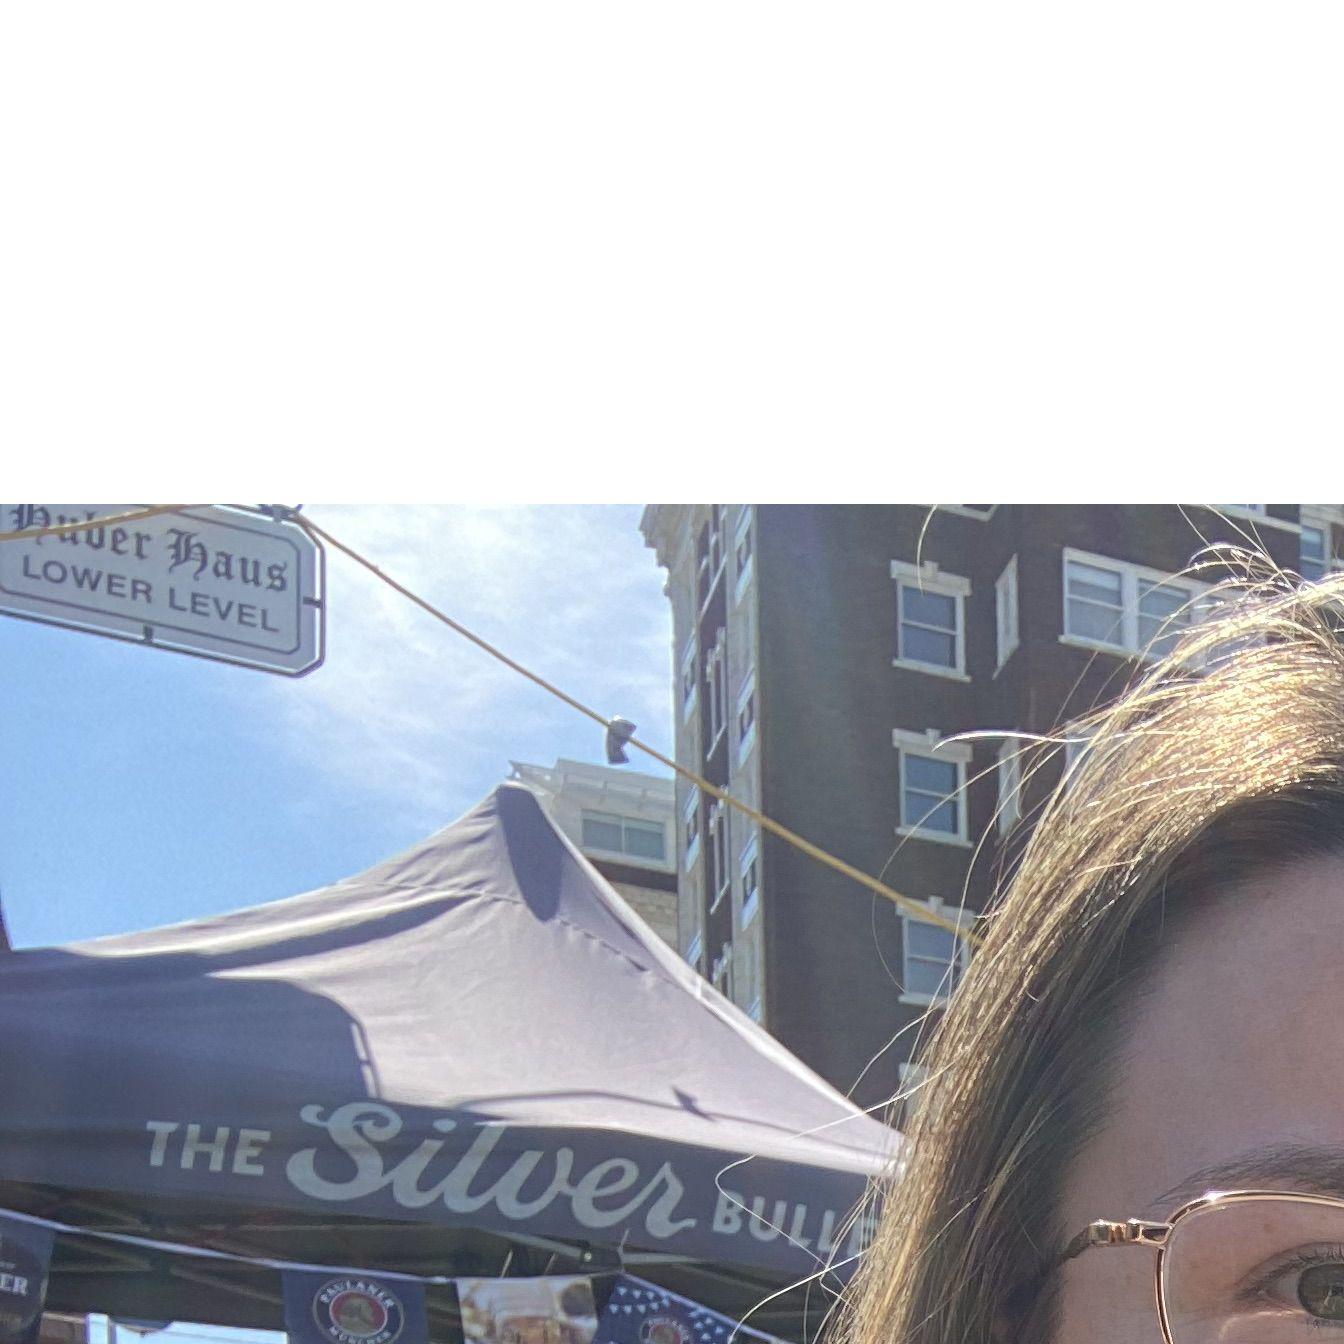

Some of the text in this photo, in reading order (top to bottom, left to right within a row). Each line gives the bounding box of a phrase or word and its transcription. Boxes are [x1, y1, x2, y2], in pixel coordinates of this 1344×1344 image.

[22, 554, 280, 632] LOWER LEVEL
[165, 528, 288, 592] Haus
[146, 1120, 271, 1176] THE
[285, 1102, 696, 1239] Silver
